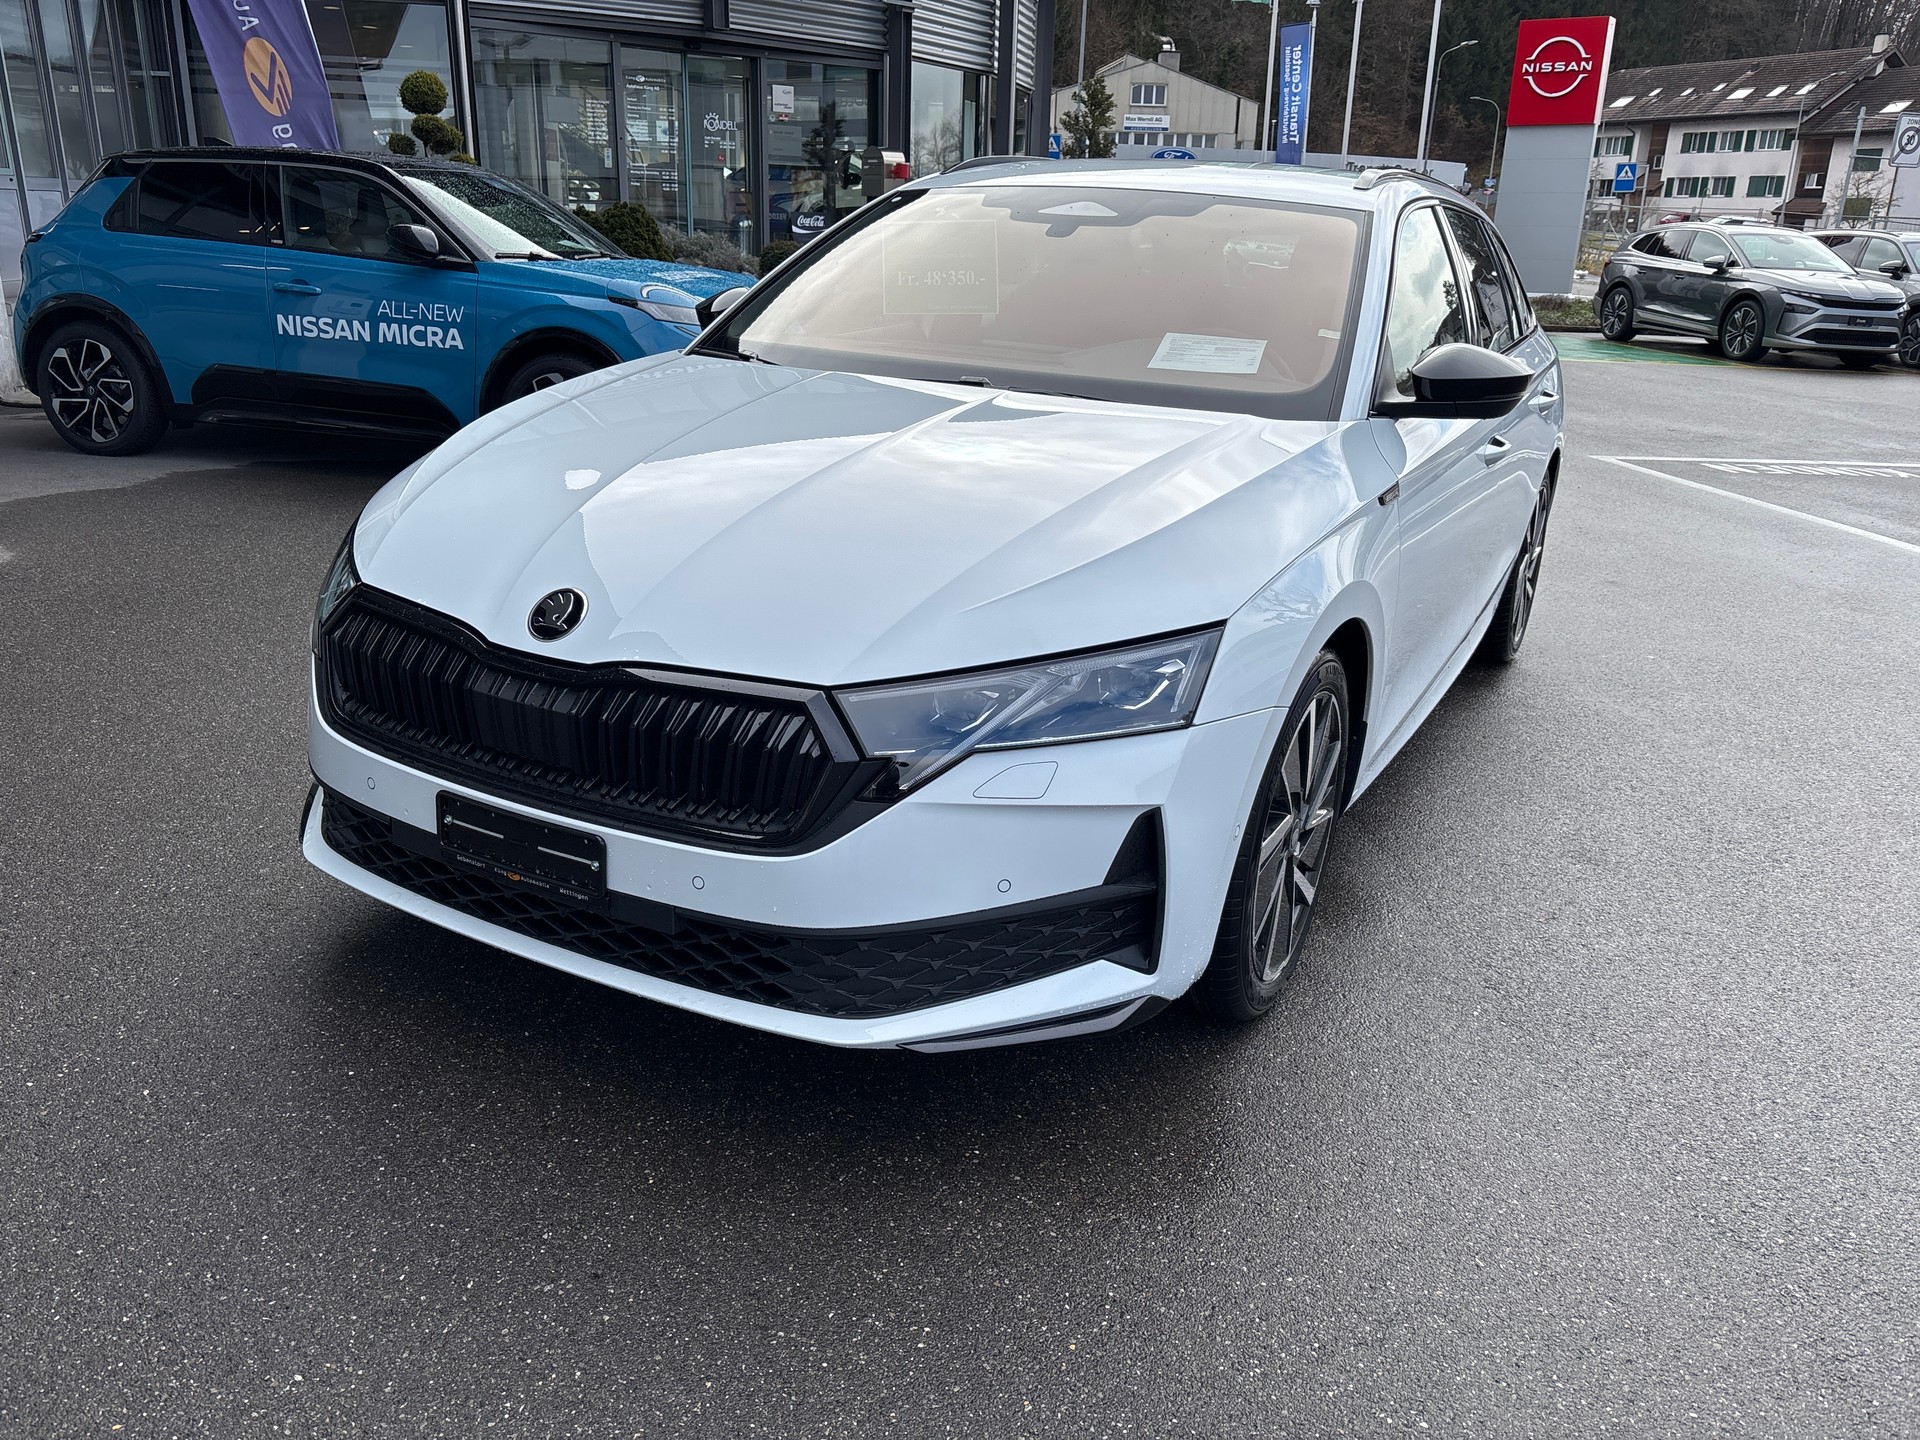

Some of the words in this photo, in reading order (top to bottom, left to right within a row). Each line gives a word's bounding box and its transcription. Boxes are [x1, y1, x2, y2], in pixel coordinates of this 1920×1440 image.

[1522, 61, 1593, 73] NISSAN
[703, 117, 738, 131] RONDELL
[1904, 134, 1916, 146] 30
[897, 271, 919, 286] Fr.
[377, 299, 465, 323] ALL-NEW
[276, 314, 371, 342] NISSAN
[378, 322, 464, 350] MICRA
[559, 887, 589, 901] Wettingen
